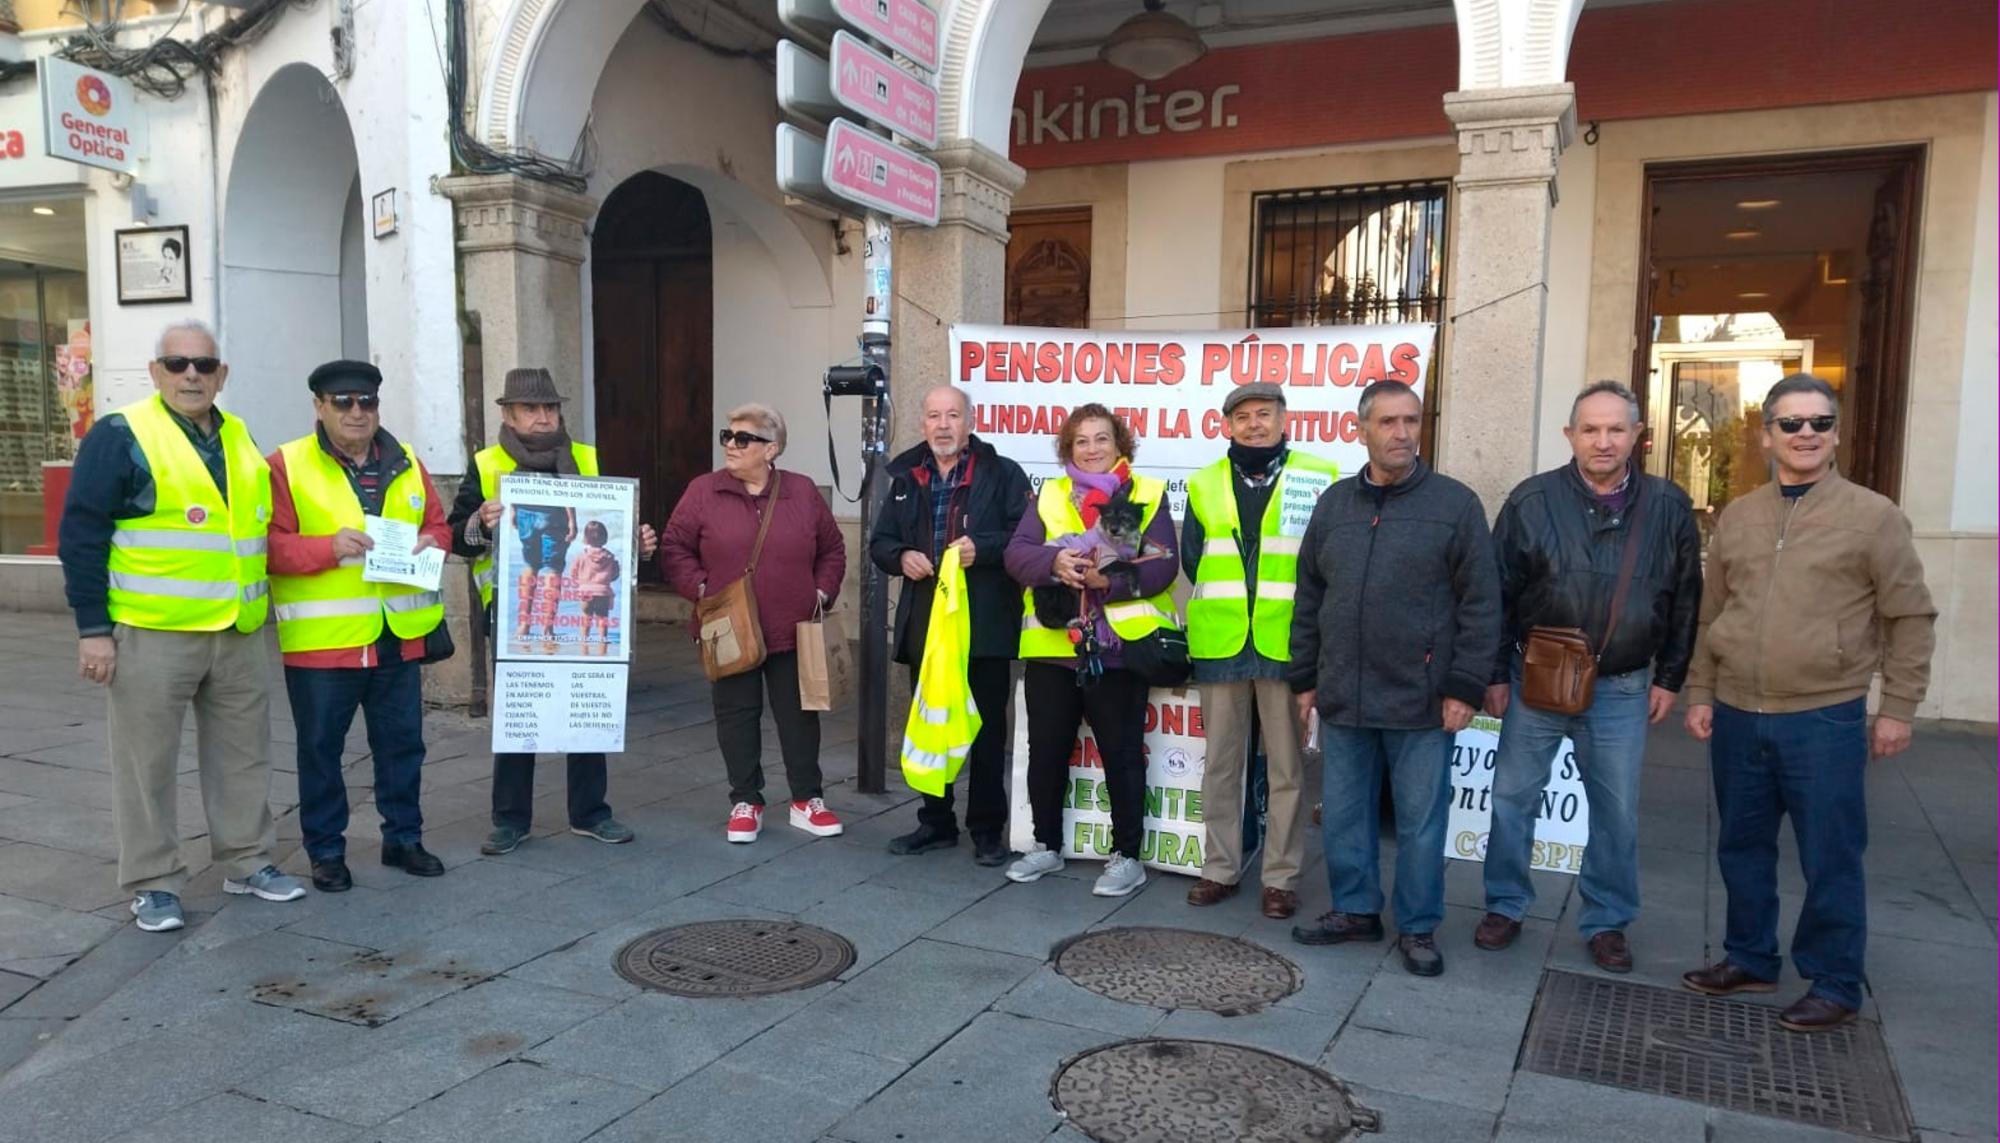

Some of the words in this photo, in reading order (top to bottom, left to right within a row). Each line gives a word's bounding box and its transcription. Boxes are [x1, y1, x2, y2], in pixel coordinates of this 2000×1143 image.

[61, 112, 130, 144] General
[68, 132, 125, 161] Optica
[960, 341, 1187, 386] PENSIONES
[1201, 333, 1421, 388] PÚBLICAS
[1158, 408, 1193, 439] LA
[553, 480, 569, 489] QUE
[570, 491, 583, 499] LOS
[1284, 488, 1312, 499] dignas
[506, 671, 546, 679] NOSOTROS
[572, 671, 586, 679] QUE
[506, 681, 519, 689] LAS
[520, 681, 555, 689] TENEMOS
[571, 681, 584, 689] LAS
[506, 691, 515, 699] EN
[517, 691, 543, 699] MAYOR
[506, 701, 533, 709] MENOR
[505, 721, 524, 729] PERO
[525, 721, 538, 729] LAS
[569, 721, 582, 729] LAS
[505, 731, 539, 739] TENEMOS
